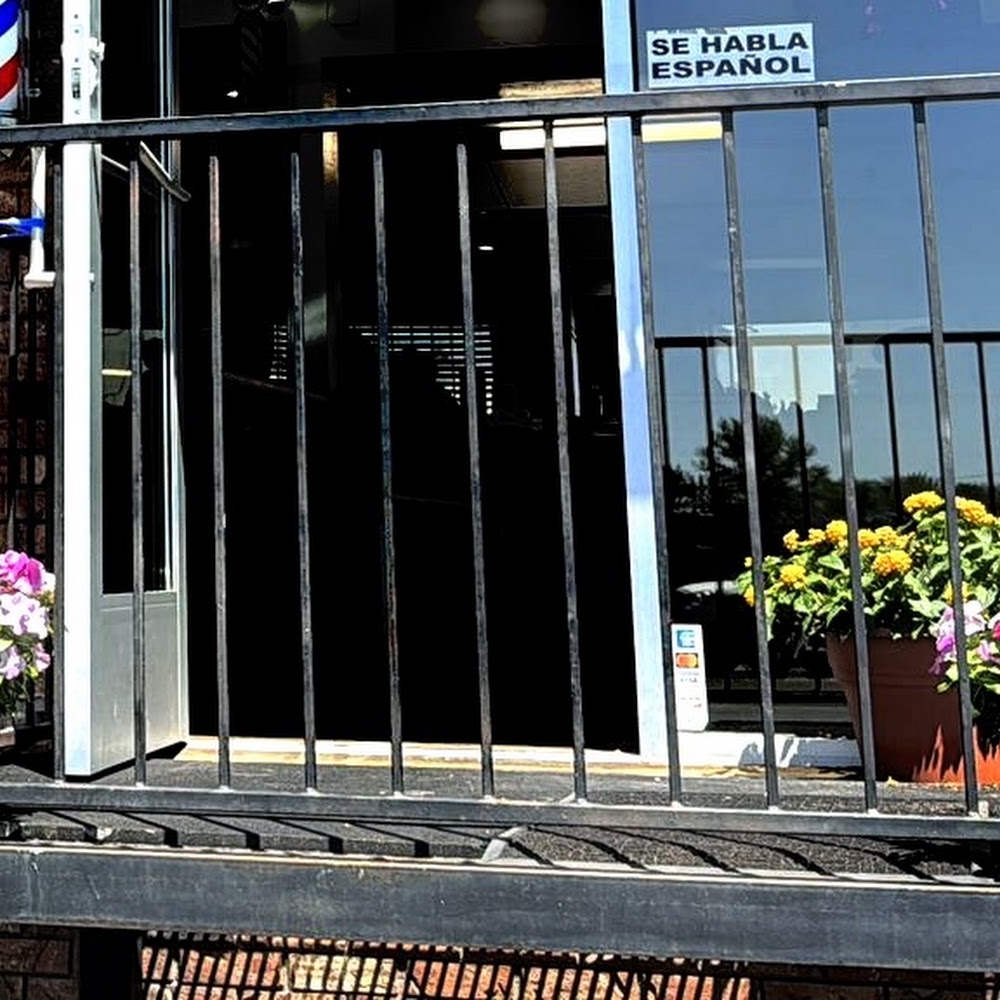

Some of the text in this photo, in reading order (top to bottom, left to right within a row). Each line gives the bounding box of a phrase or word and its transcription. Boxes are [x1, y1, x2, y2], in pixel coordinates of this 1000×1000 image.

[651, 32, 809, 56] SE HABLA
[651, 53, 812, 80] ESPAÑOL
